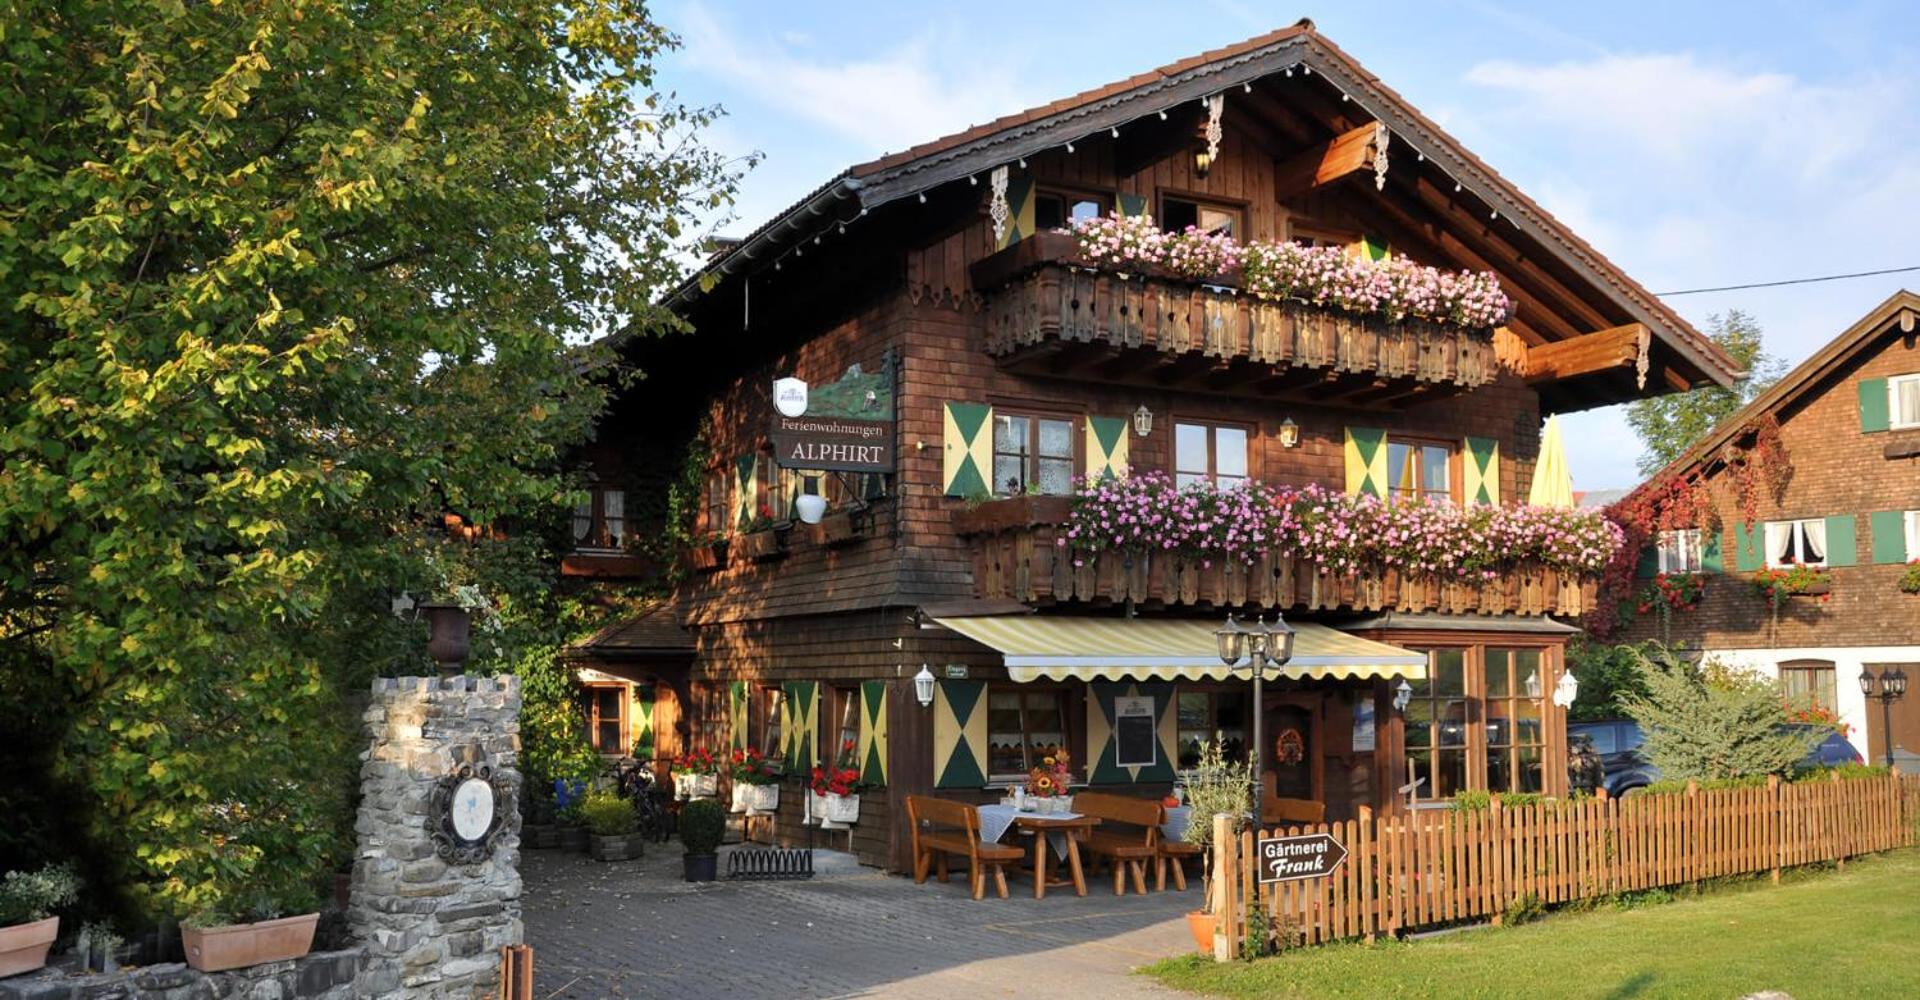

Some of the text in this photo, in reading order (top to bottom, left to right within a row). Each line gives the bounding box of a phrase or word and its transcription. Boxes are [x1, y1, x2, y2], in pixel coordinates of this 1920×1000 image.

[781, 418, 883, 438] Ferienwohnungen
[791, 442, 884, 463] ALPHIRT
[1265, 839, 1328, 858] Gärtnerei
[1269, 855, 1324, 878] Frank
